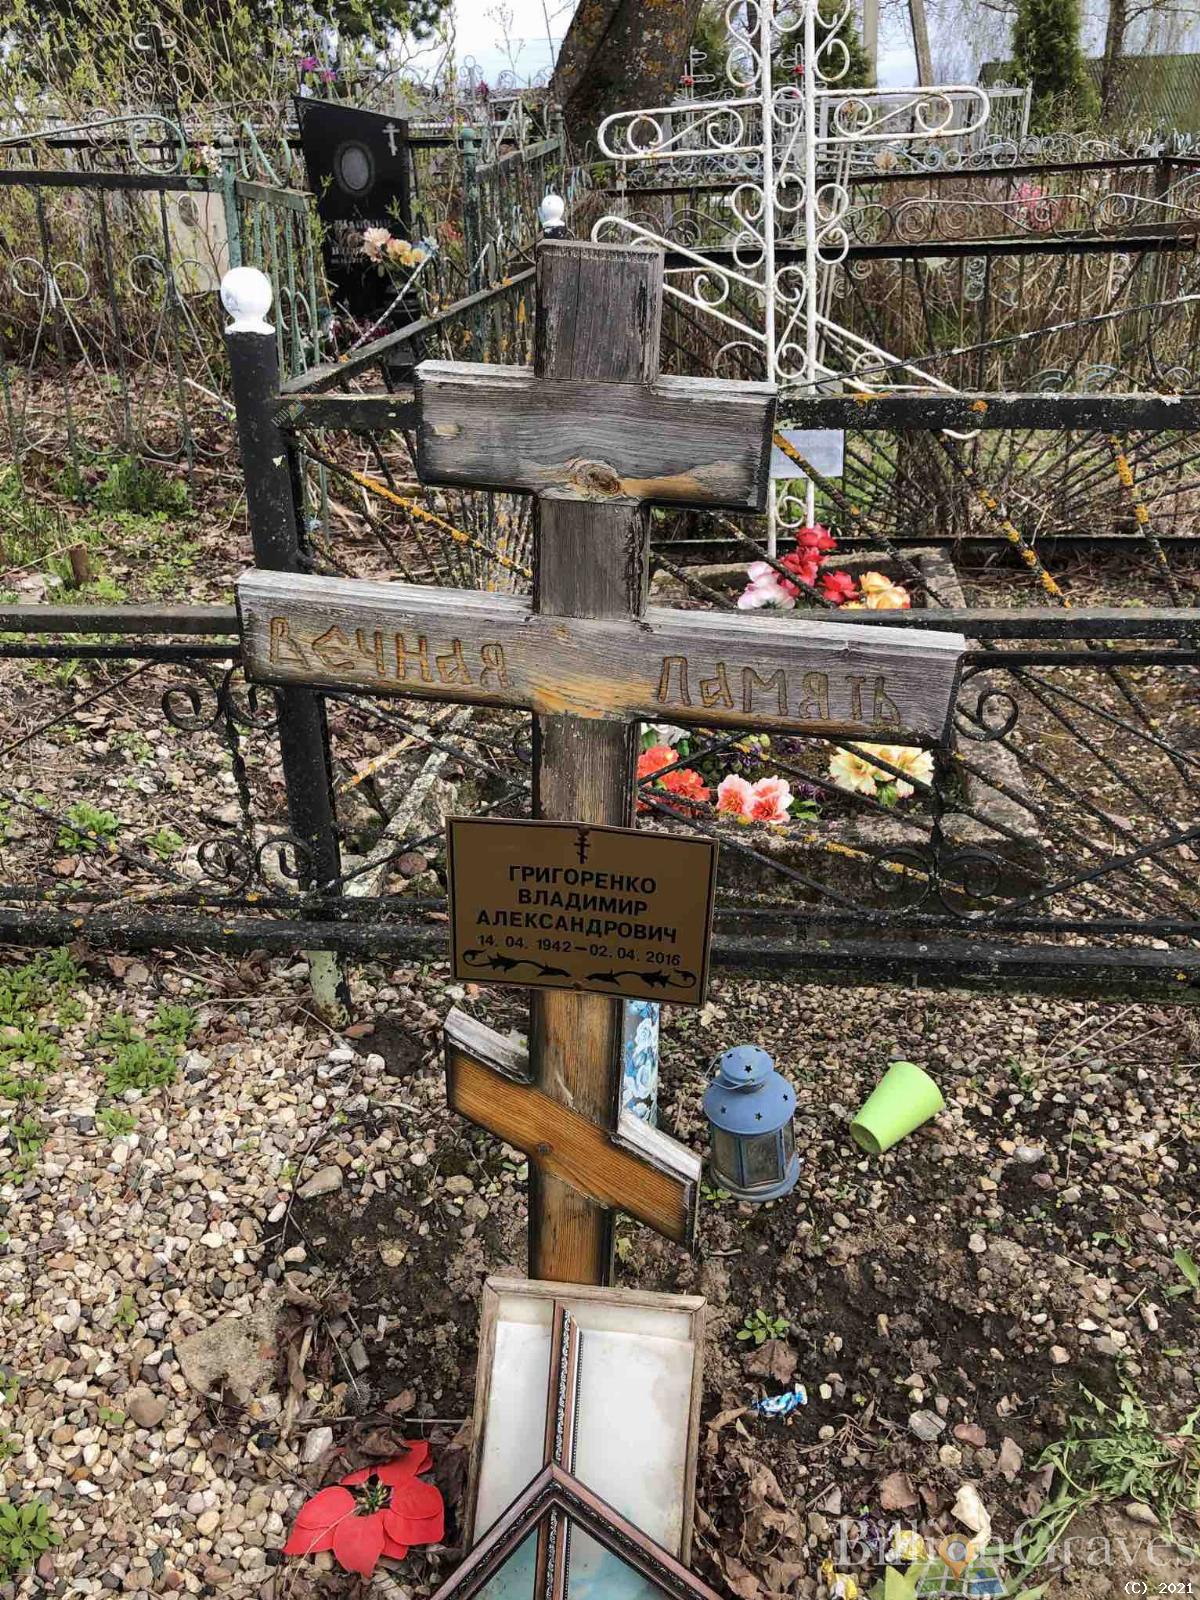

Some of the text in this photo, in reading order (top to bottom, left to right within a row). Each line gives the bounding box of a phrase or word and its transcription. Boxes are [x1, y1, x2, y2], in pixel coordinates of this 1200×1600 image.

[509, 865, 657, 894] ГРИГОРЕНКО
[518, 889, 648, 917] ВЛАДИМИР
[476, 910, 677, 944] АЛЕКСАНДРОВИЧ
[646, 951, 681, 966] 2016
